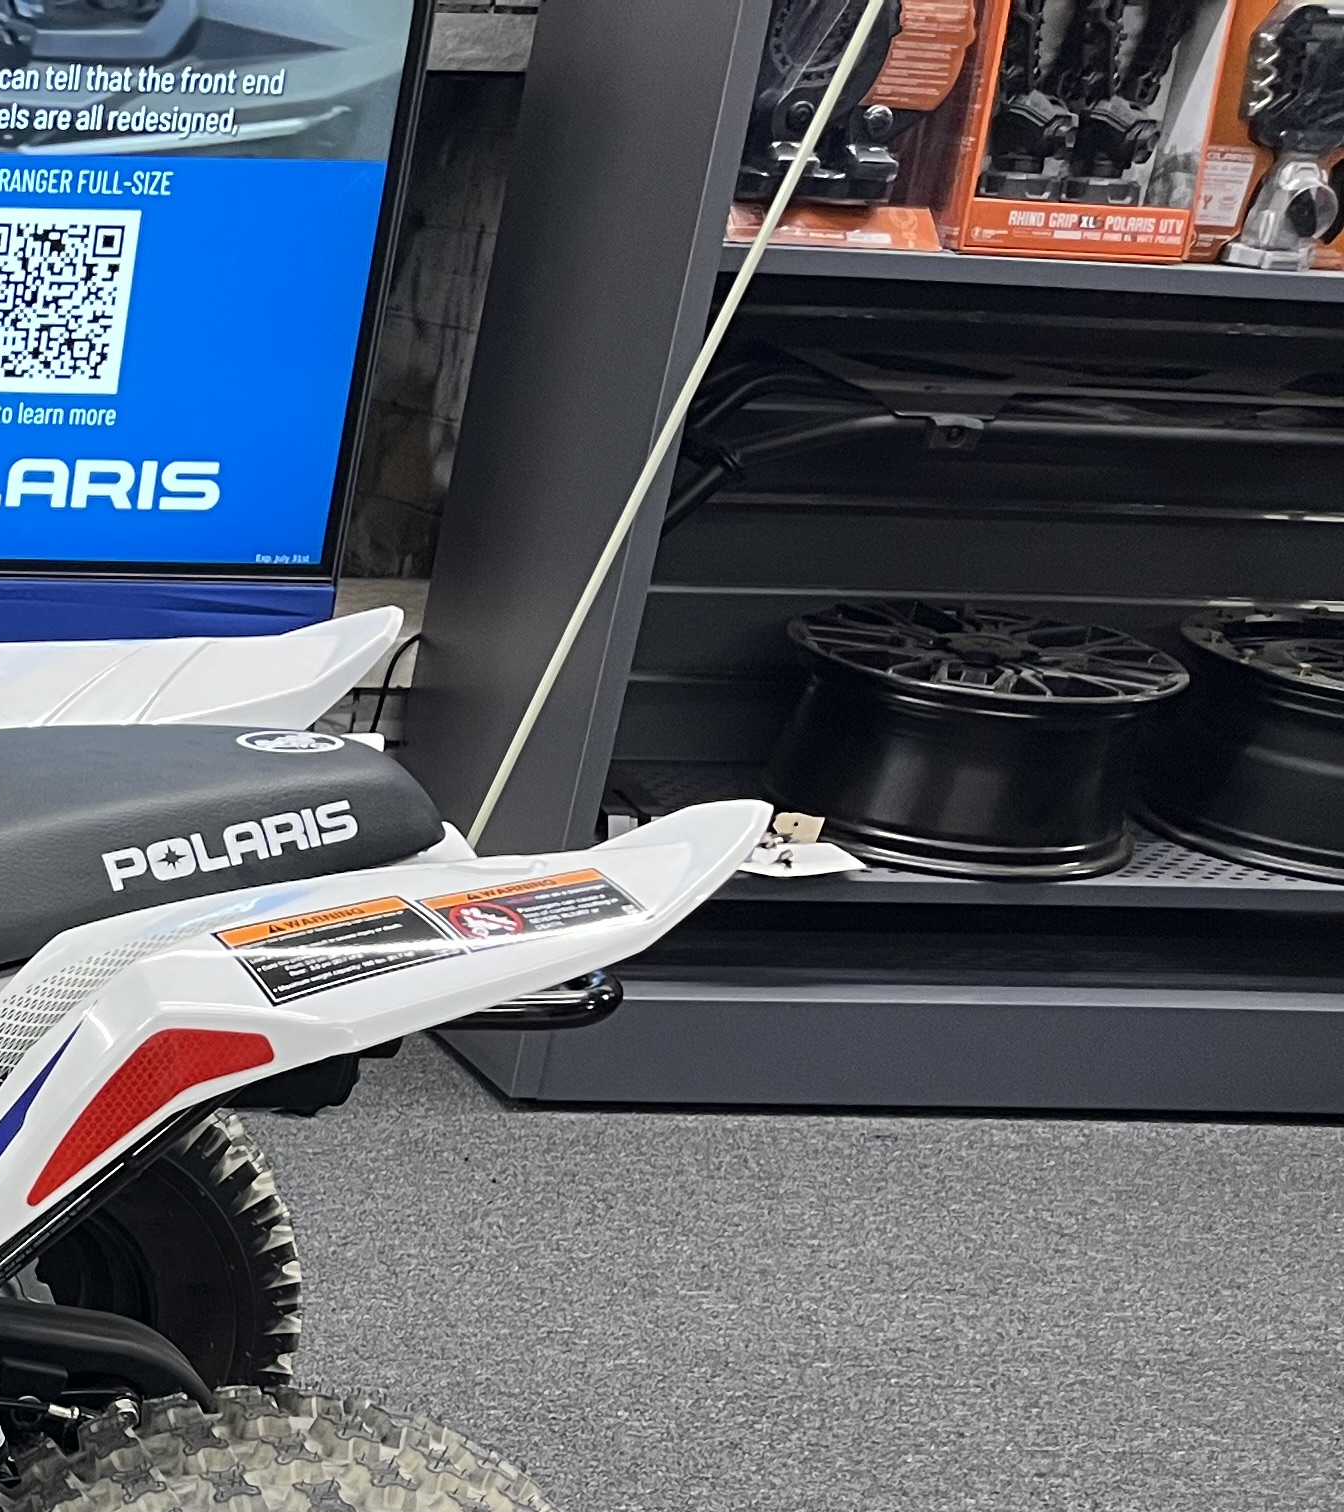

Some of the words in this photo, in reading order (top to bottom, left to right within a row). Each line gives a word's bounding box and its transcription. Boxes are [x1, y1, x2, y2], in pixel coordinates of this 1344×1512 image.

[45, 63, 81, 92] tell
[86, 64, 132, 93] that
[138, 65, 175, 94] the
[179, 65, 237, 95] front
[241, 69, 285, 96] end
[33, 110, 72, 132] are
[75, 105, 105, 132] all
[107, 106, 240, 140] redesigned,
[76, 169, 174, 196] FULL-SIZE
[1008, 210, 1045, 227] RHINO
[1049, 212, 1077, 228] GRIP
[1079, 215, 1097, 229] XL
[1104, 215, 1156, 232] POLARIS
[1159, 218, 1185, 234] UTV
[17, 402, 64, 425] learn
[68, 407, 117, 427] more
[101, 799, 359, 892] POLARIS
[478, 879, 557, 898] WARNING
[283, 907, 366, 933] WARNING
